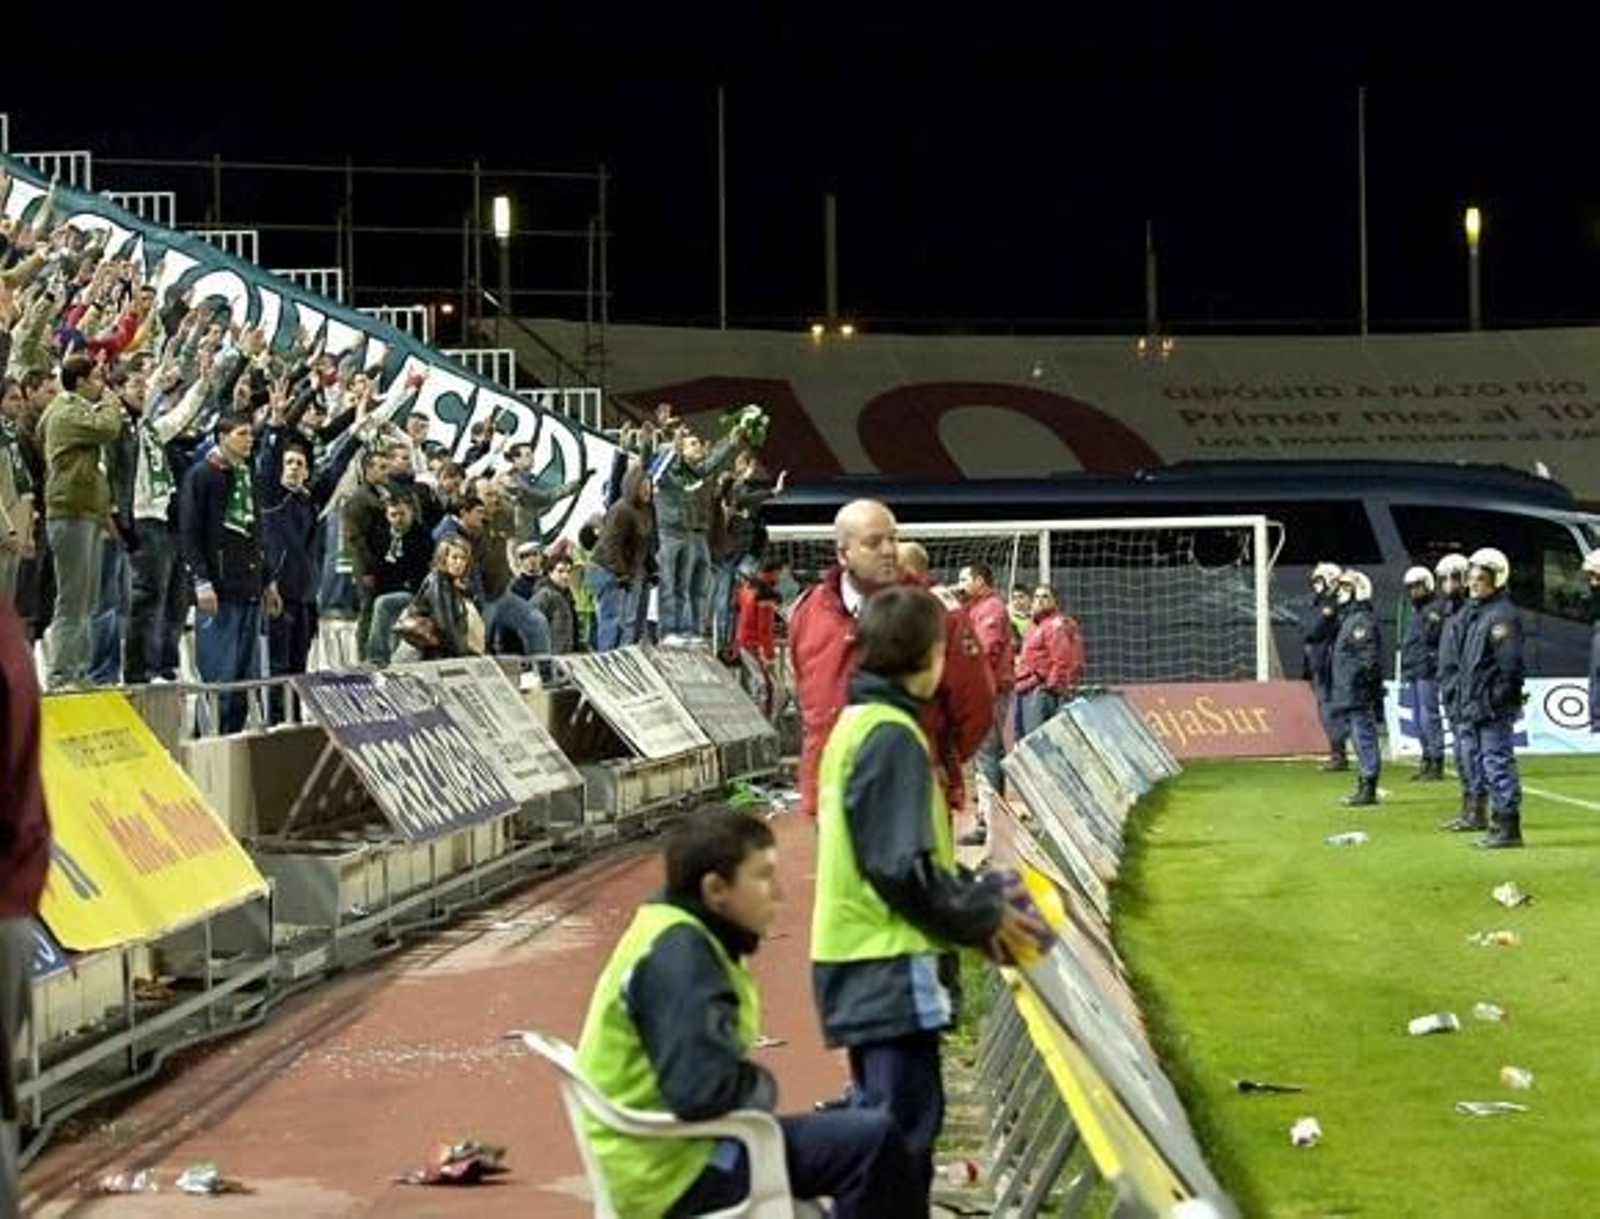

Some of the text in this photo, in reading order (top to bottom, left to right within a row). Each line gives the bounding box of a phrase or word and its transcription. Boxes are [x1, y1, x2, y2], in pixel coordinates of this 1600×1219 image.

[1177, 407, 1341, 428] Primer
[1362, 408, 1462, 424] mes
[1478, 403, 1522, 422] al
